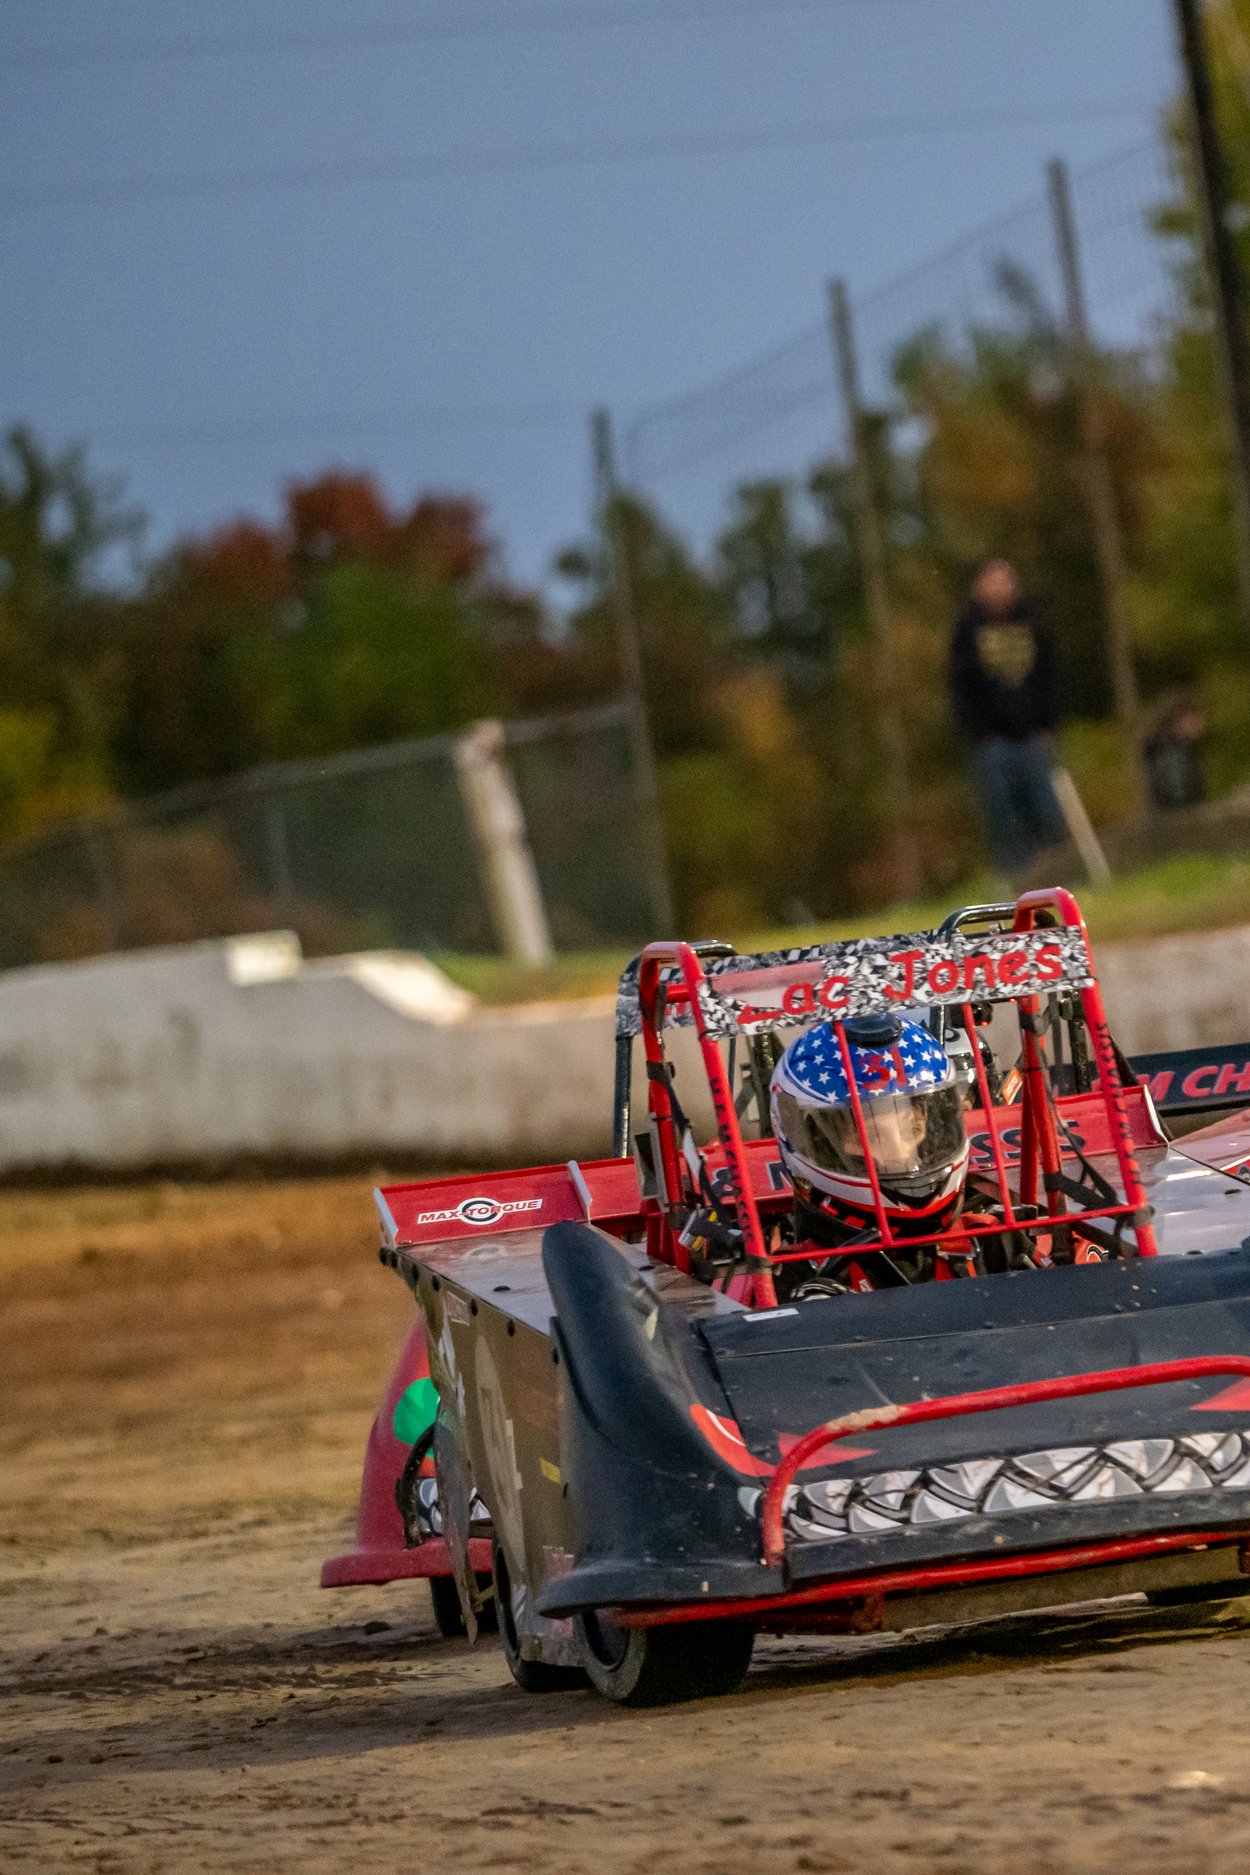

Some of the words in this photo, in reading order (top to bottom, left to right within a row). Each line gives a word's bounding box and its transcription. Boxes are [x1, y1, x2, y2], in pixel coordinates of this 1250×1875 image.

[736, 976, 850, 1025] ac
[883, 945, 1063, 1000] Jones
[859, 1042, 909, 1091] 31
